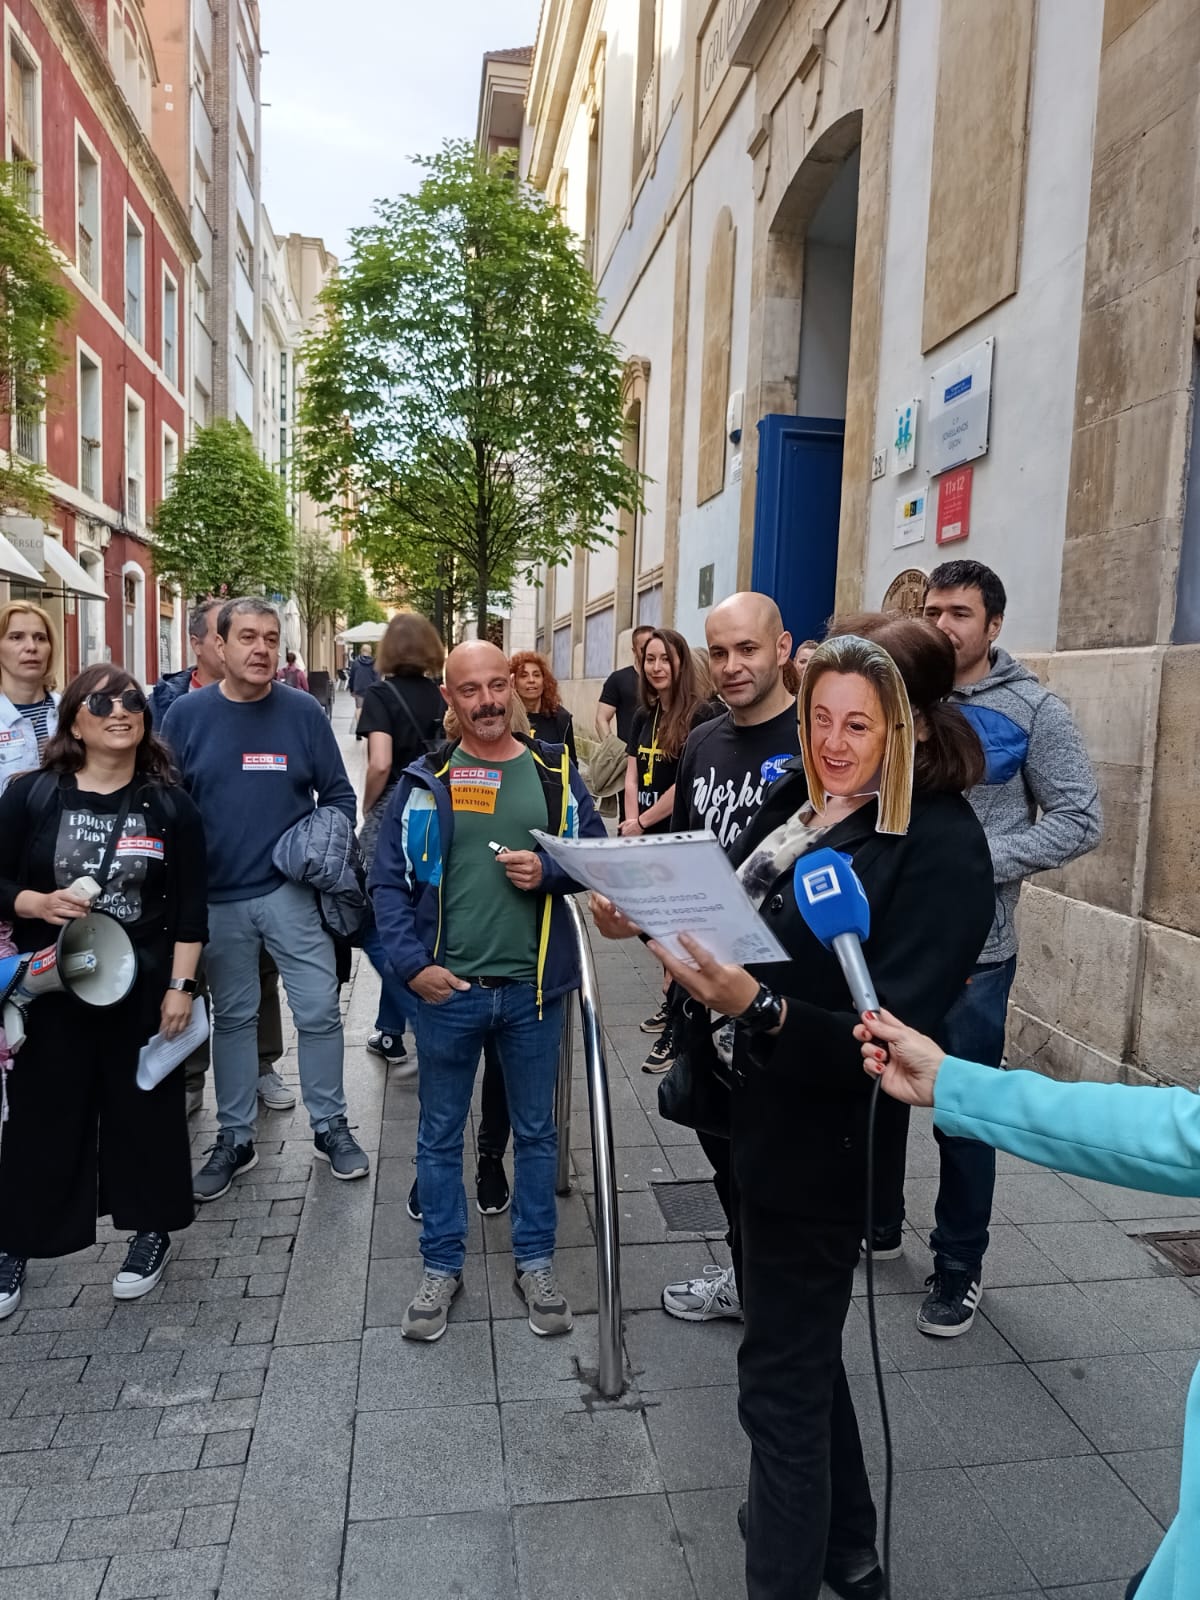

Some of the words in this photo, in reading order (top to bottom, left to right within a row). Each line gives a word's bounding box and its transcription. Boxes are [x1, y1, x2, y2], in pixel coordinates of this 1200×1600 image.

[453, 787, 494, 796] SERVICIOS
[693, 766, 767, 816] Worki
[69, 813, 137, 832] EDUCACN
